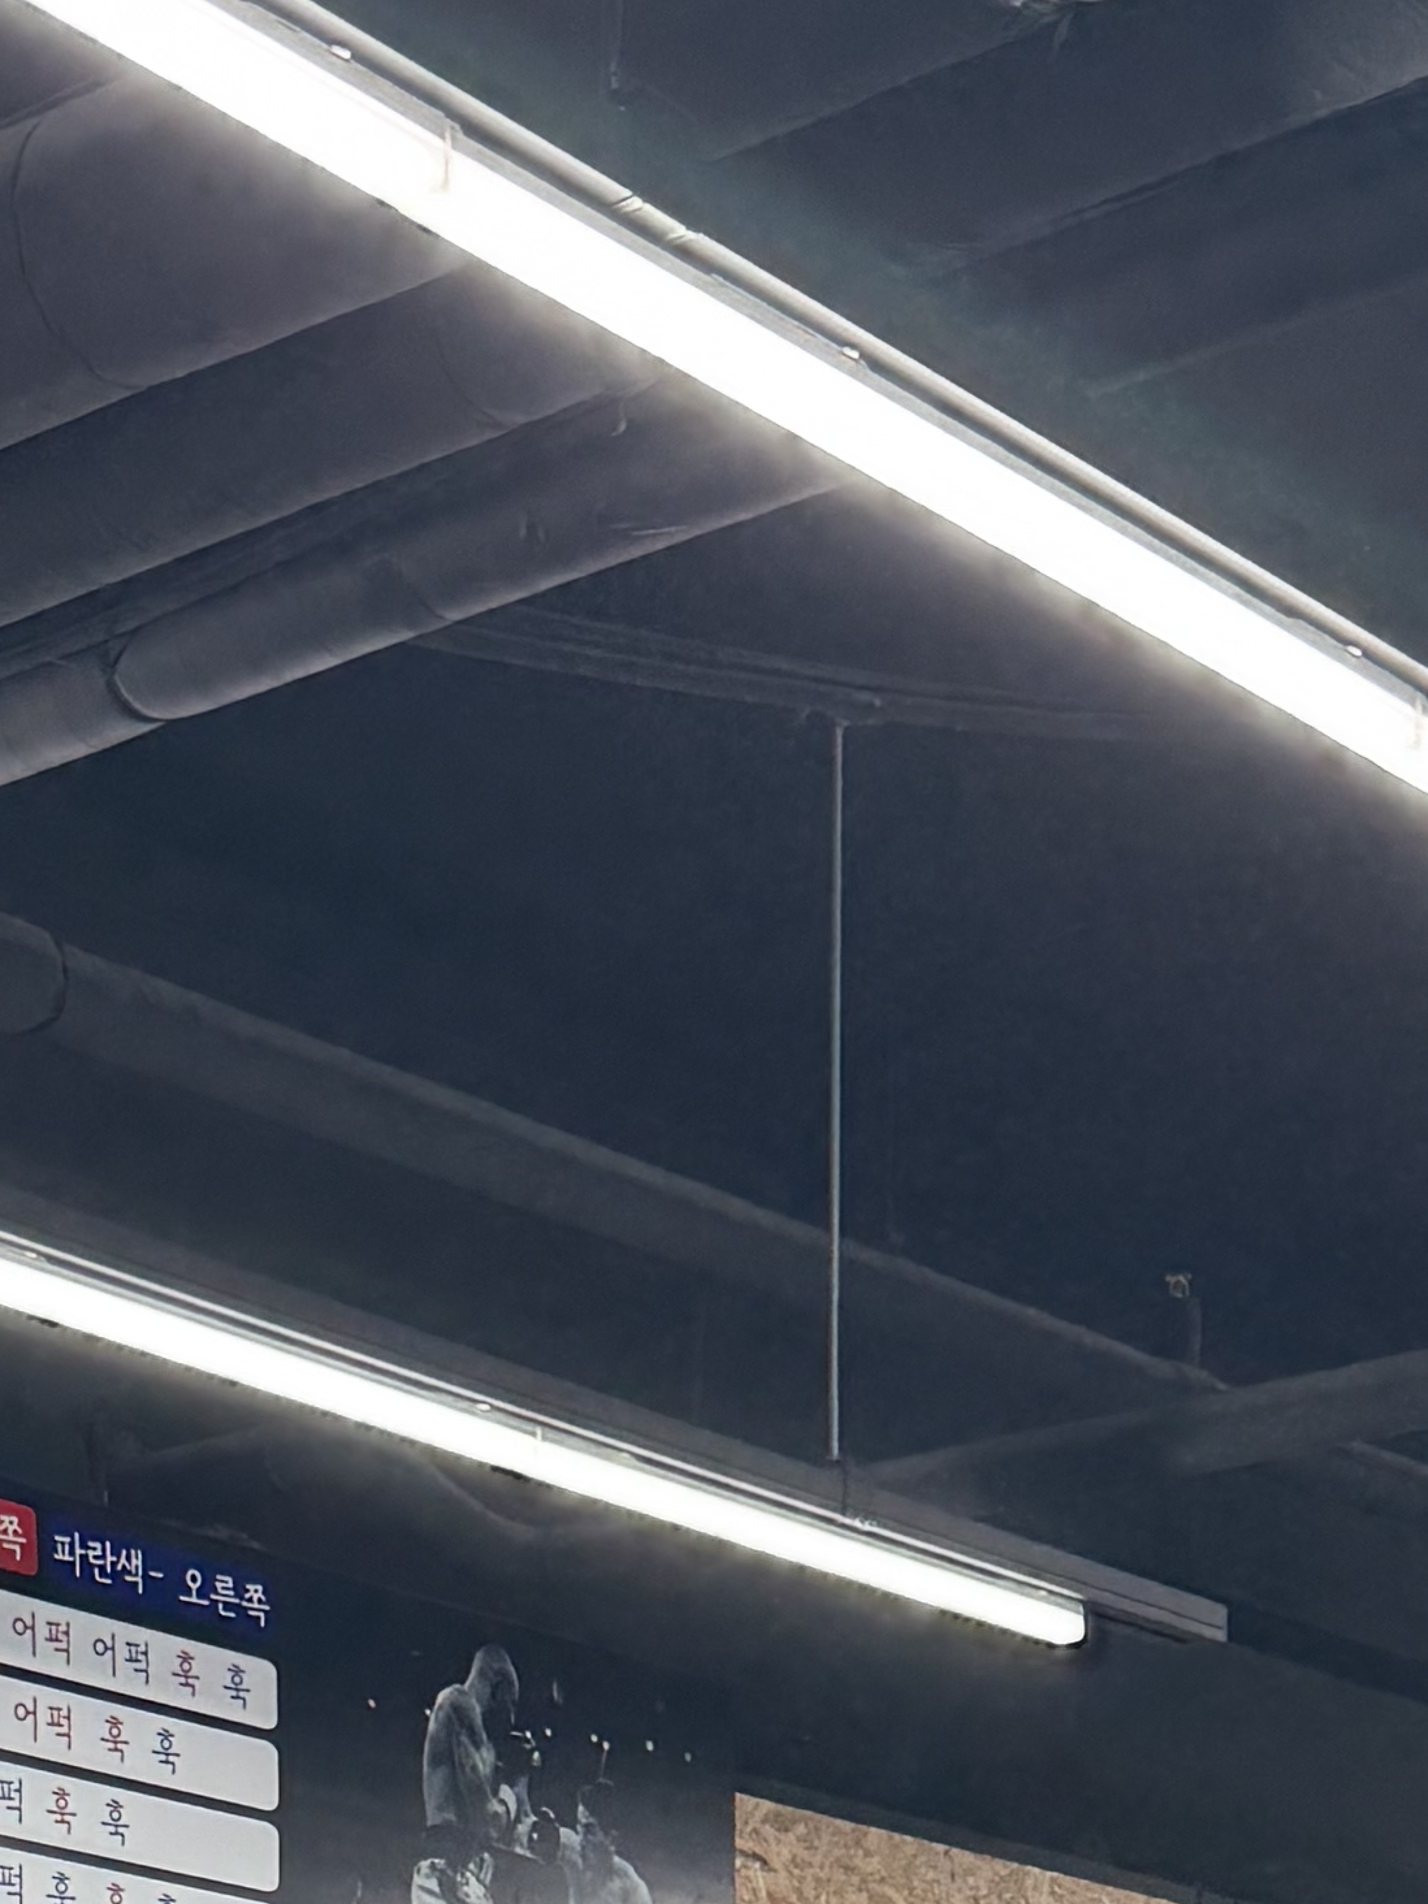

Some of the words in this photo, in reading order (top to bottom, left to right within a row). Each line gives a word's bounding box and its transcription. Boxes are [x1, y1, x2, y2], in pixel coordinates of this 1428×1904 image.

[178, 1568, 271, 1628] 오른쪽
[171, 1649, 201, 1698] 훅
[222, 1663, 252, 1711] 훅
[99, 1714, 131, 1764] 훅
[151, 1727, 182, 1776] 훅
[45, 1786, 78, 1836] 훅
[99, 1798, 131, 1847] 훅
